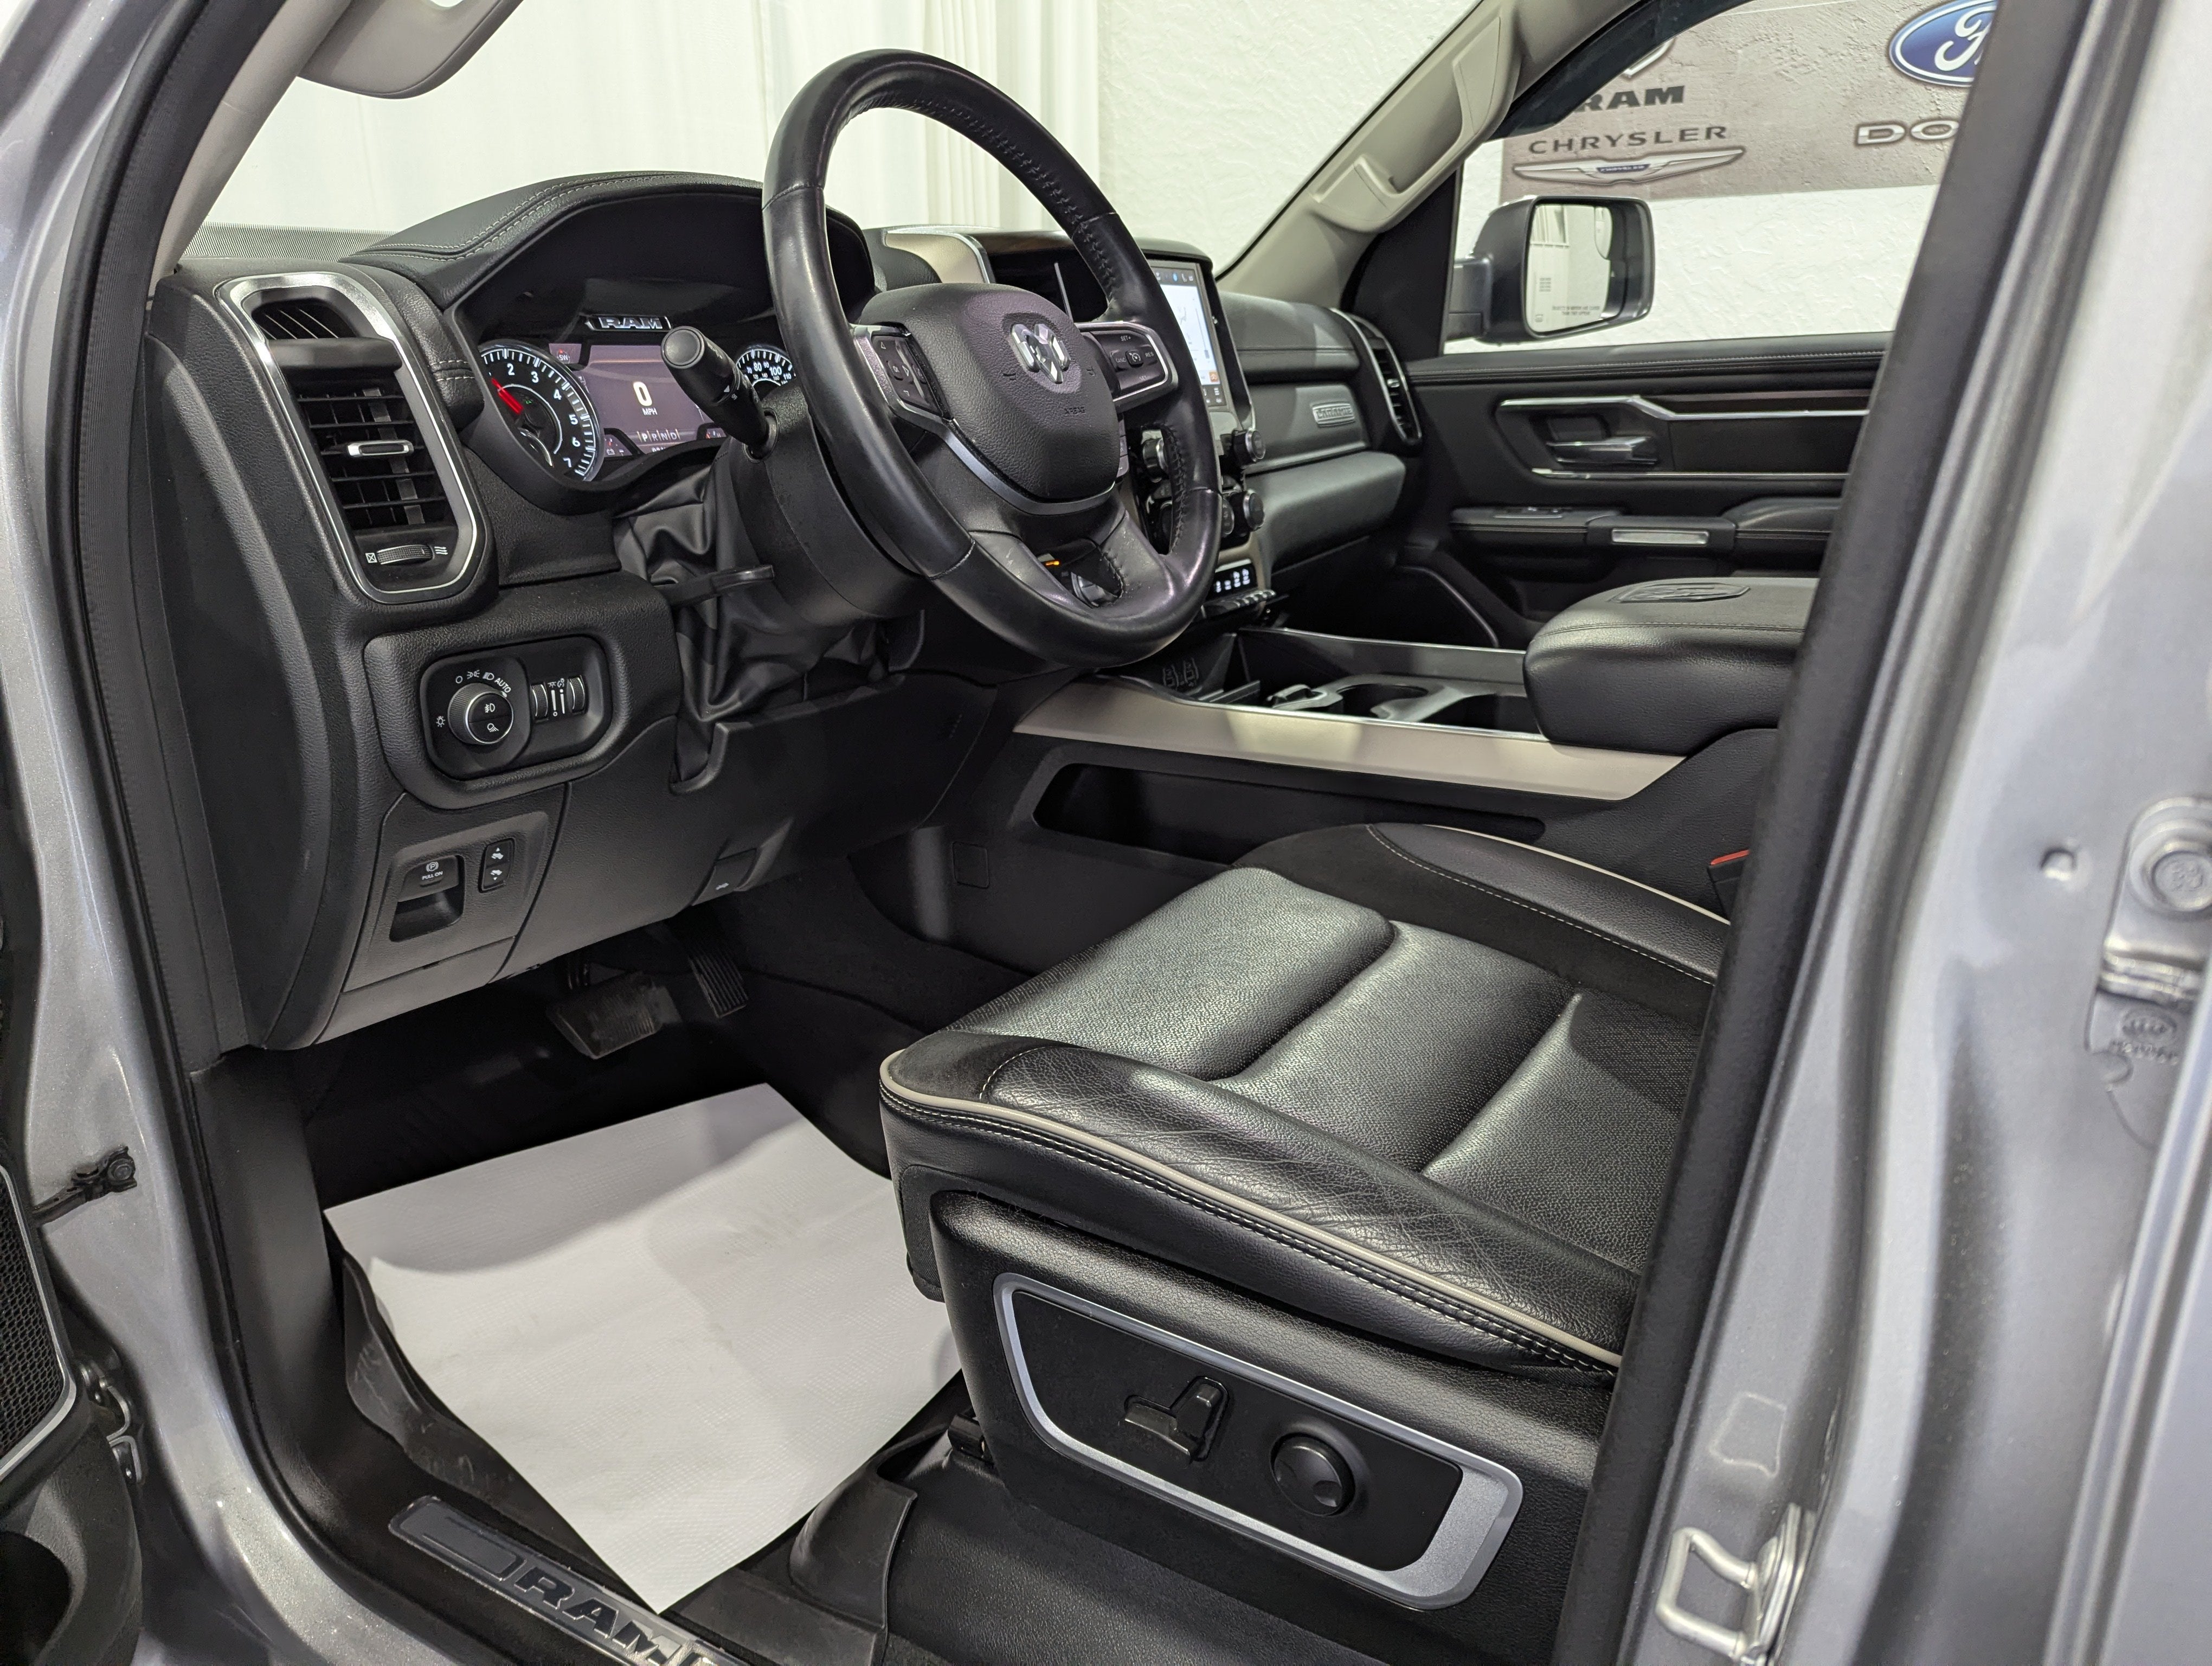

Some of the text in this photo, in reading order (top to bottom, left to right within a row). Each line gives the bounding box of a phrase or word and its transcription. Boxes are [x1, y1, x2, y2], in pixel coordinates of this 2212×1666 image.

[1528, 125, 1727, 155] CHRYSLER
[599, 317, 663, 329] RAM
[507, 363, 515, 376] 2
[753, 361, 762, 372] 80
[769, 366, 782, 376] 100
[531, 371, 539, 383] 3
[554, 389, 562, 400] 4
[633, 381, 653, 407] 0
[641, 407, 658, 416] MPH
[569, 414, 578, 425] 5
[572, 437, 581, 447] 6
[642, 432, 678, 442] P R N D
[563, 457, 572, 467] 7
[494, 677, 511, 694] AUTO
[513, 1565, 683, 1666] RAM
